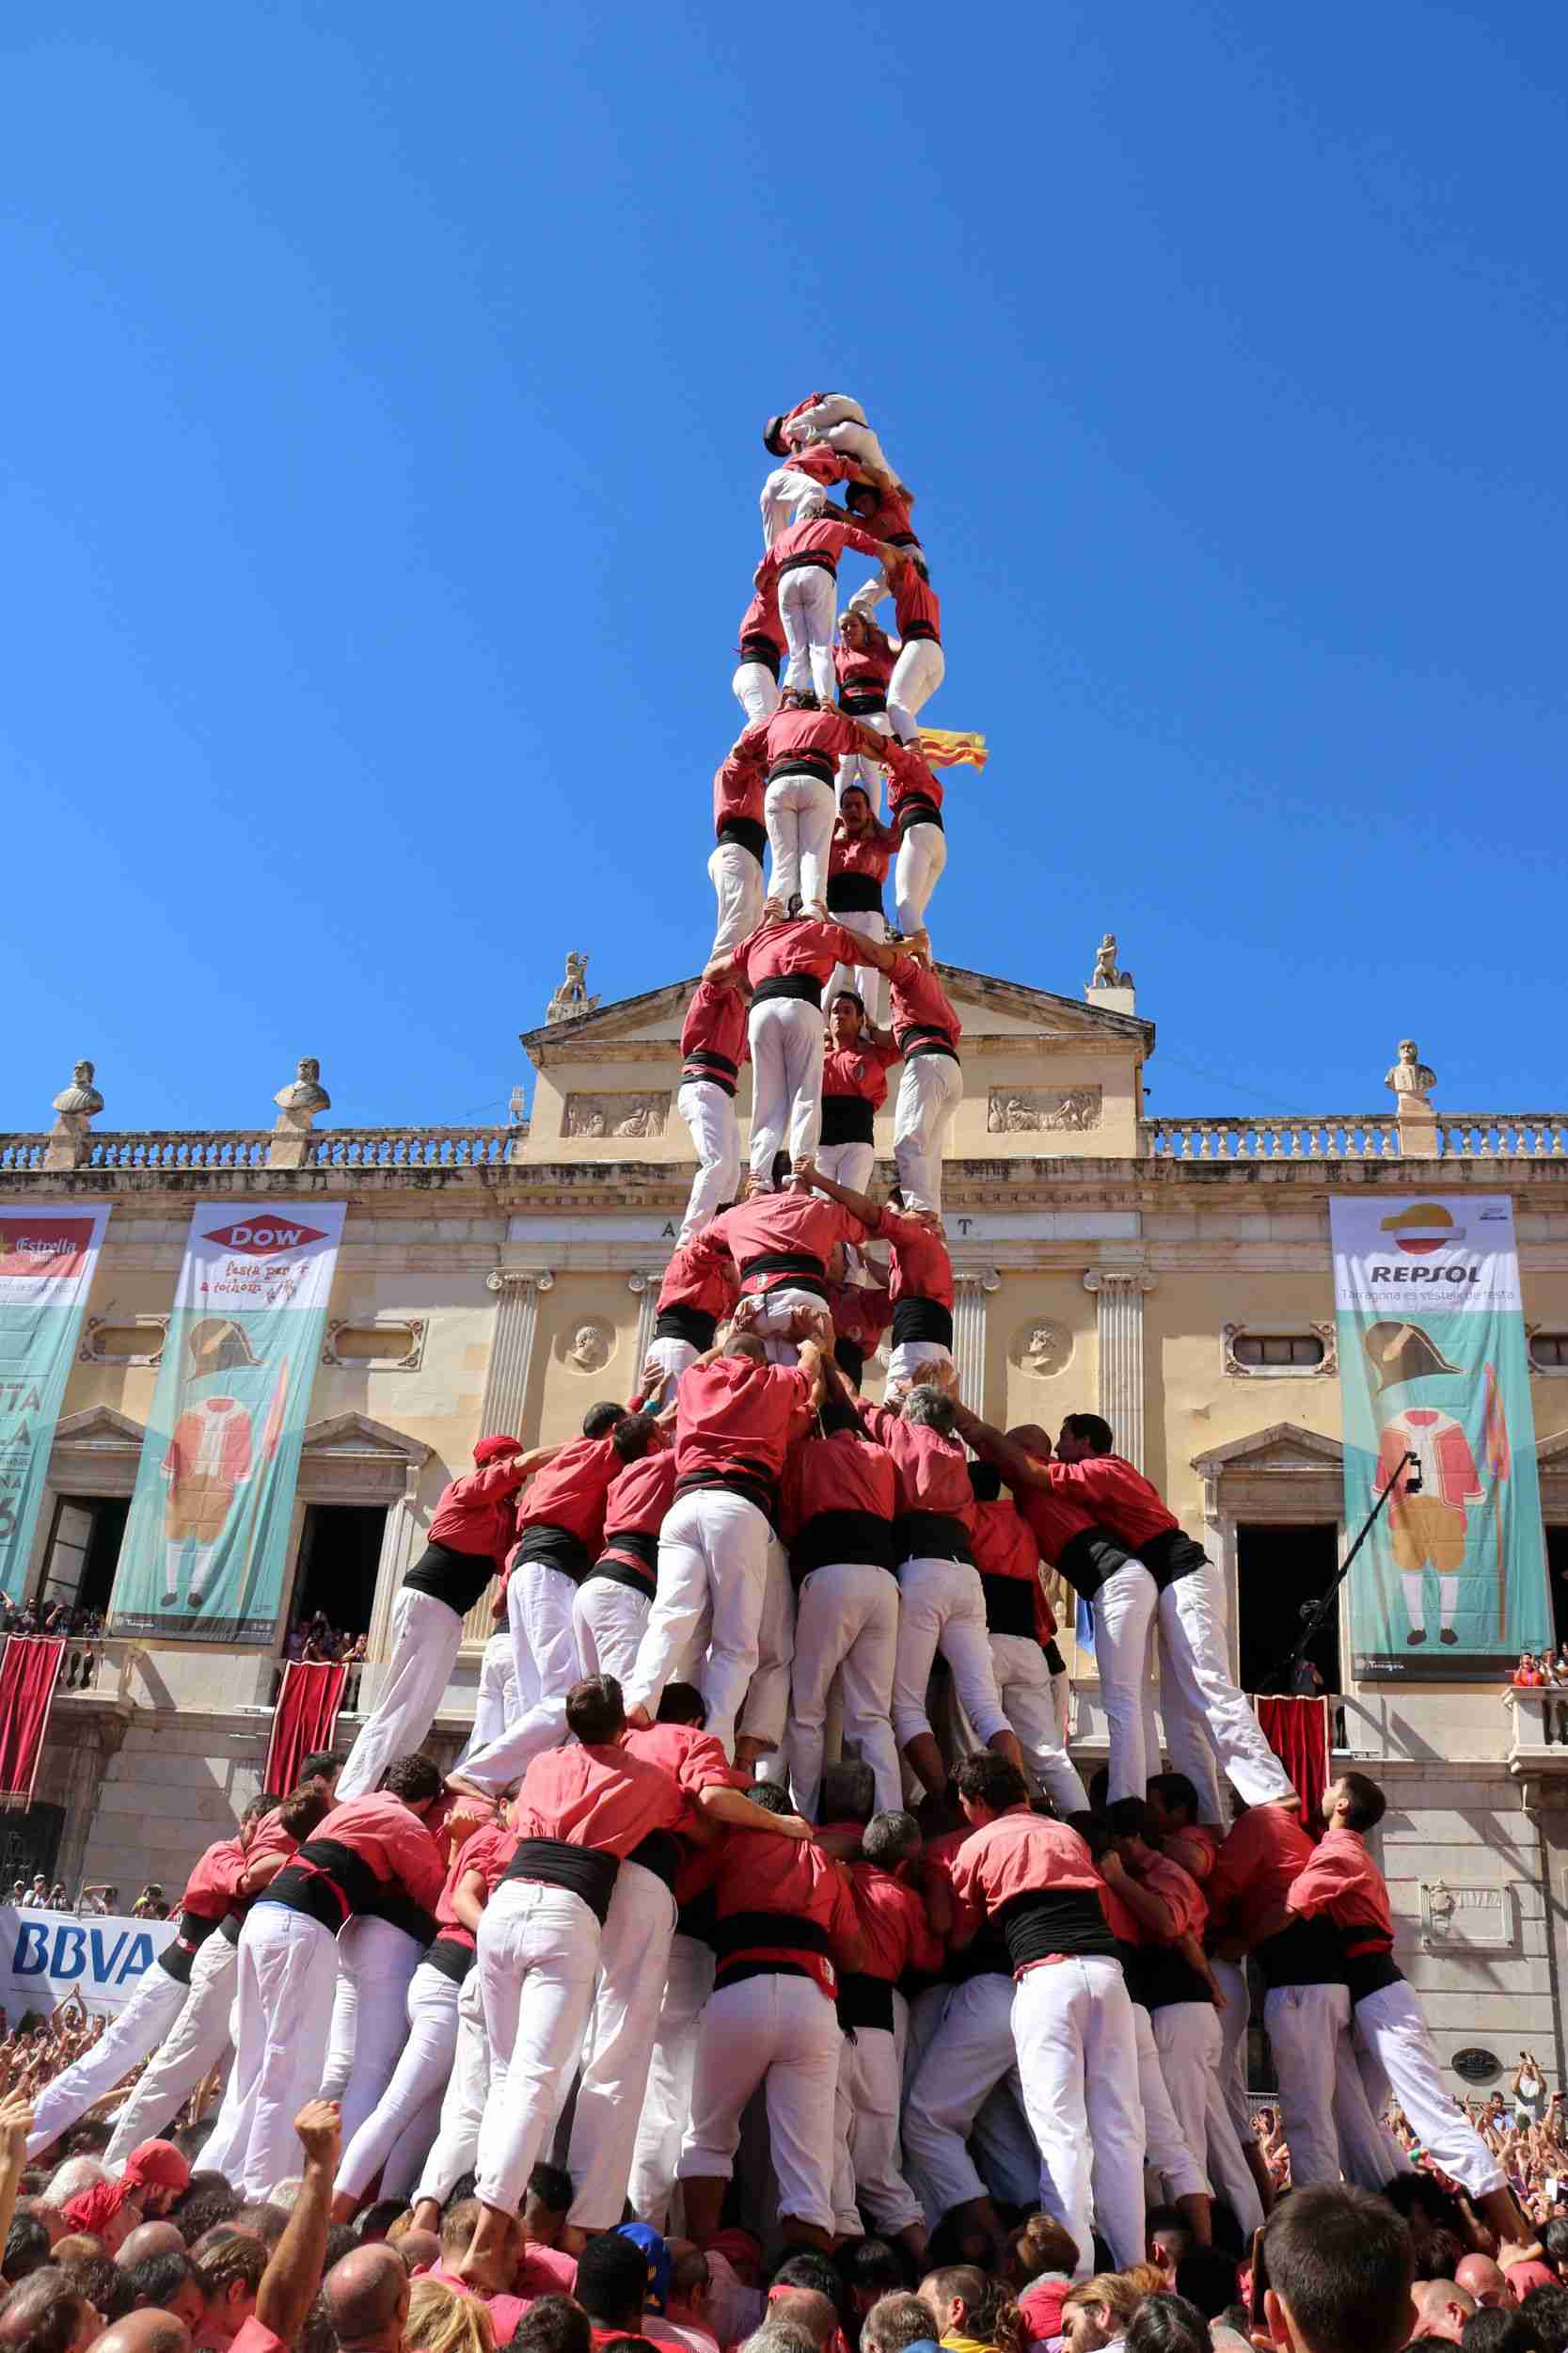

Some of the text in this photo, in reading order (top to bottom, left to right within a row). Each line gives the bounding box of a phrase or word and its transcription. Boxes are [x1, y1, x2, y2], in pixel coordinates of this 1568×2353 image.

[16, 1235, 76, 1254] Estrella
[230, 1227, 304, 1246] DOW
[1370, 1265, 1481, 1283] REPSOL
[1339, 1289, 1401, 1303] Tarragona
[0, 1384, 40, 1411] TA
[12, 1921, 155, 1985] BBVA
